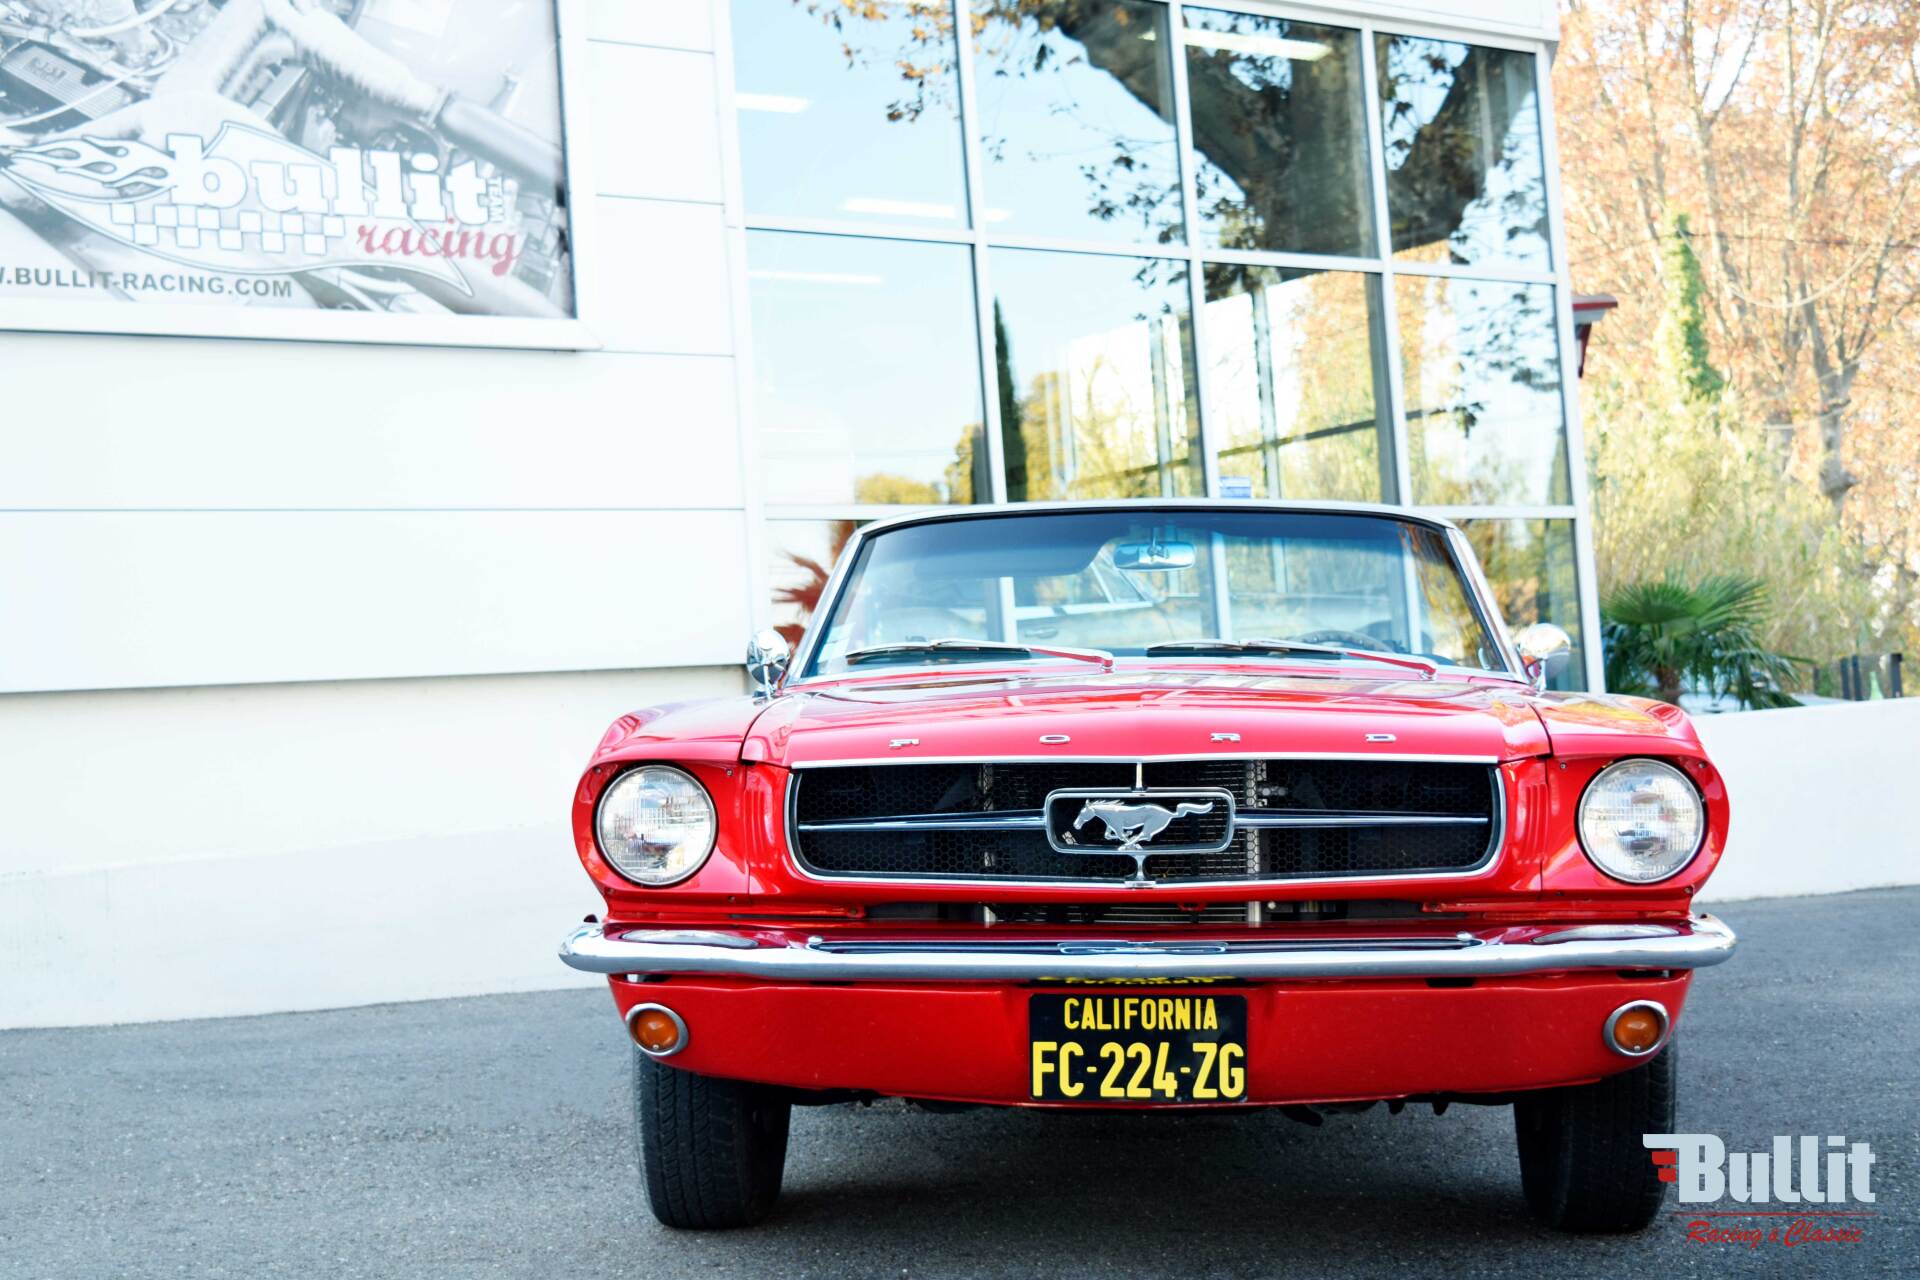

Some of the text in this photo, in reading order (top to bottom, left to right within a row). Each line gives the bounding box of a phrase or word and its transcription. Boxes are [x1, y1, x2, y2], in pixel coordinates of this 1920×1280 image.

[167, 133, 489, 226] bullit
[356, 217, 521, 277] racing
[0, 267, 292, 297] .BULLIT-RACING.COM
[1064, 998, 1218, 1030] CALIFORNIA
[1032, 1041, 1244, 1098] FC-224-ZG
